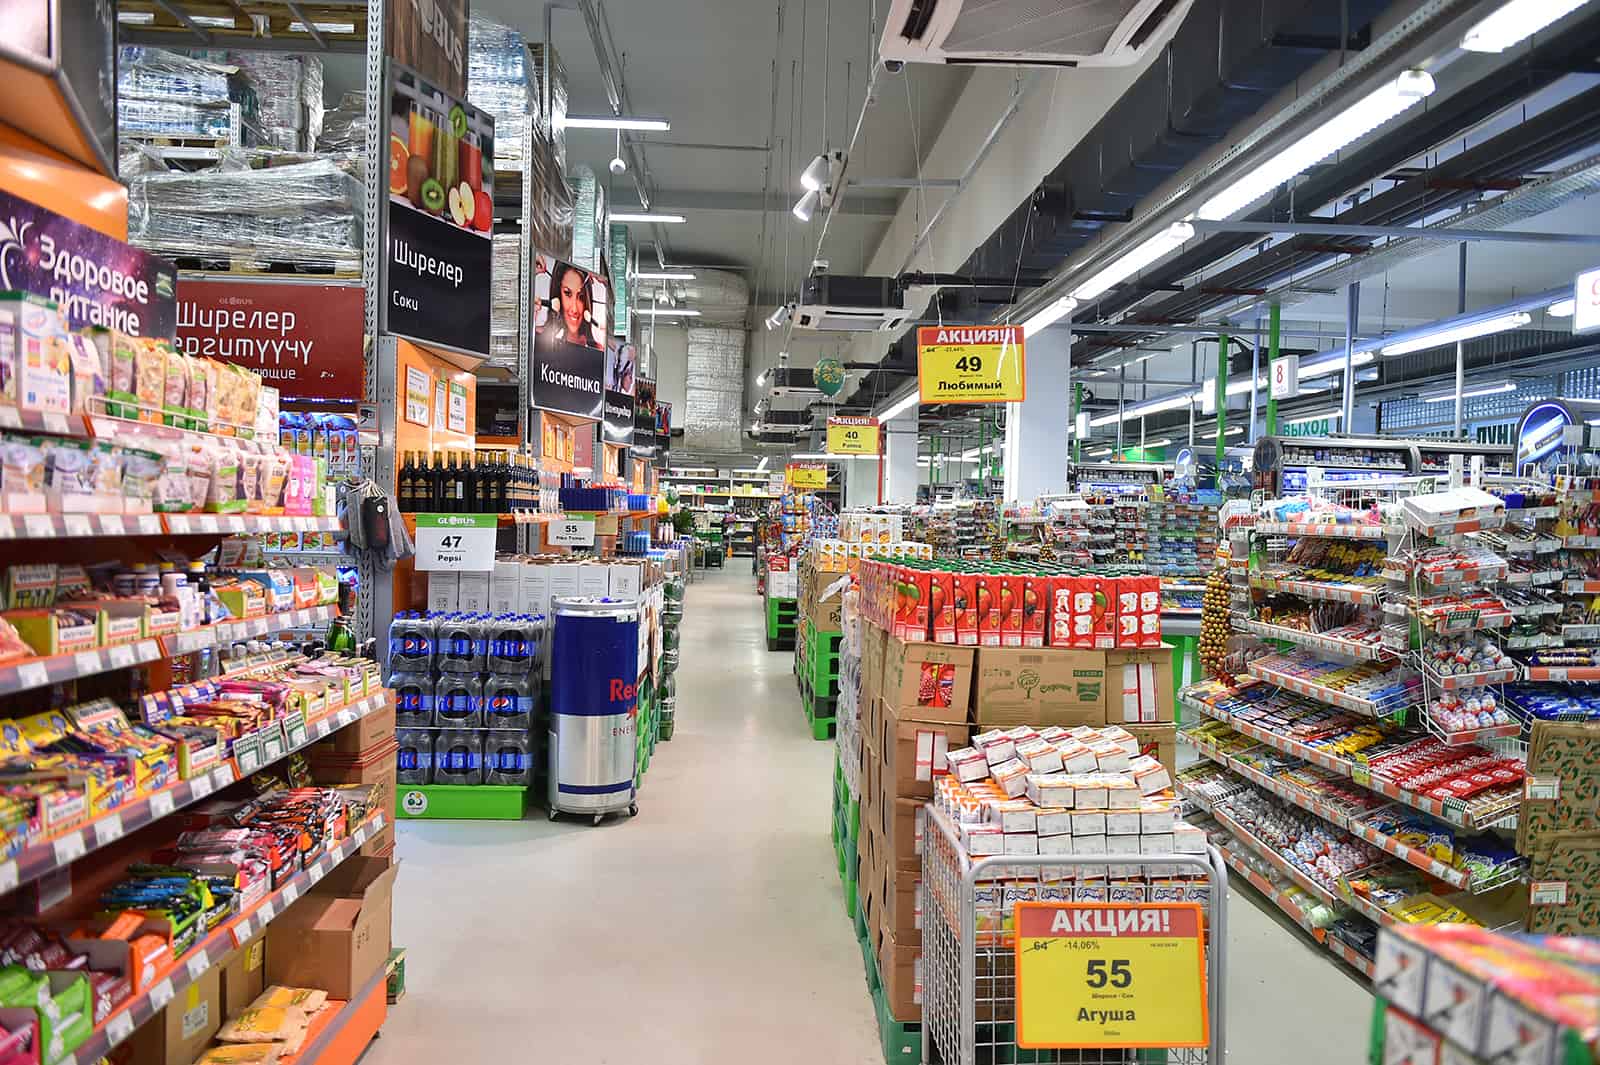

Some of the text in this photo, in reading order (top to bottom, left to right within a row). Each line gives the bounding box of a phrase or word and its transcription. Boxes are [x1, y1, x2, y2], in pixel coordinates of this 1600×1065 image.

[39, 233, 149, 304] Здоровое
[394, 239, 463, 288] Ширелер
[393, 290, 418, 311] Соки
[176, 301, 296, 337] Ширелер
[936, 330, 1005, 344] АКЦИЯ!
[955, 356, 982, 372] 49
[541, 362, 601, 393] Косметика
[1276, 364, 1283, 384] 8
[938, 380, 1002, 391] Любимый
[845, 431, 858, 440] 40
[1283, 418, 1329, 437] ВЫХОД
[565, 525, 578, 533] 55
[441, 535, 463, 549] 47
[438, 554, 462, 563] Pepsi
[1051, 909, 1171, 937] АКЦИЯ!
[1064, 940, 1100, 951] -14,06%
[1086, 959, 1133, 988] 55
[1077, 1007, 1137, 1025] Агуша
